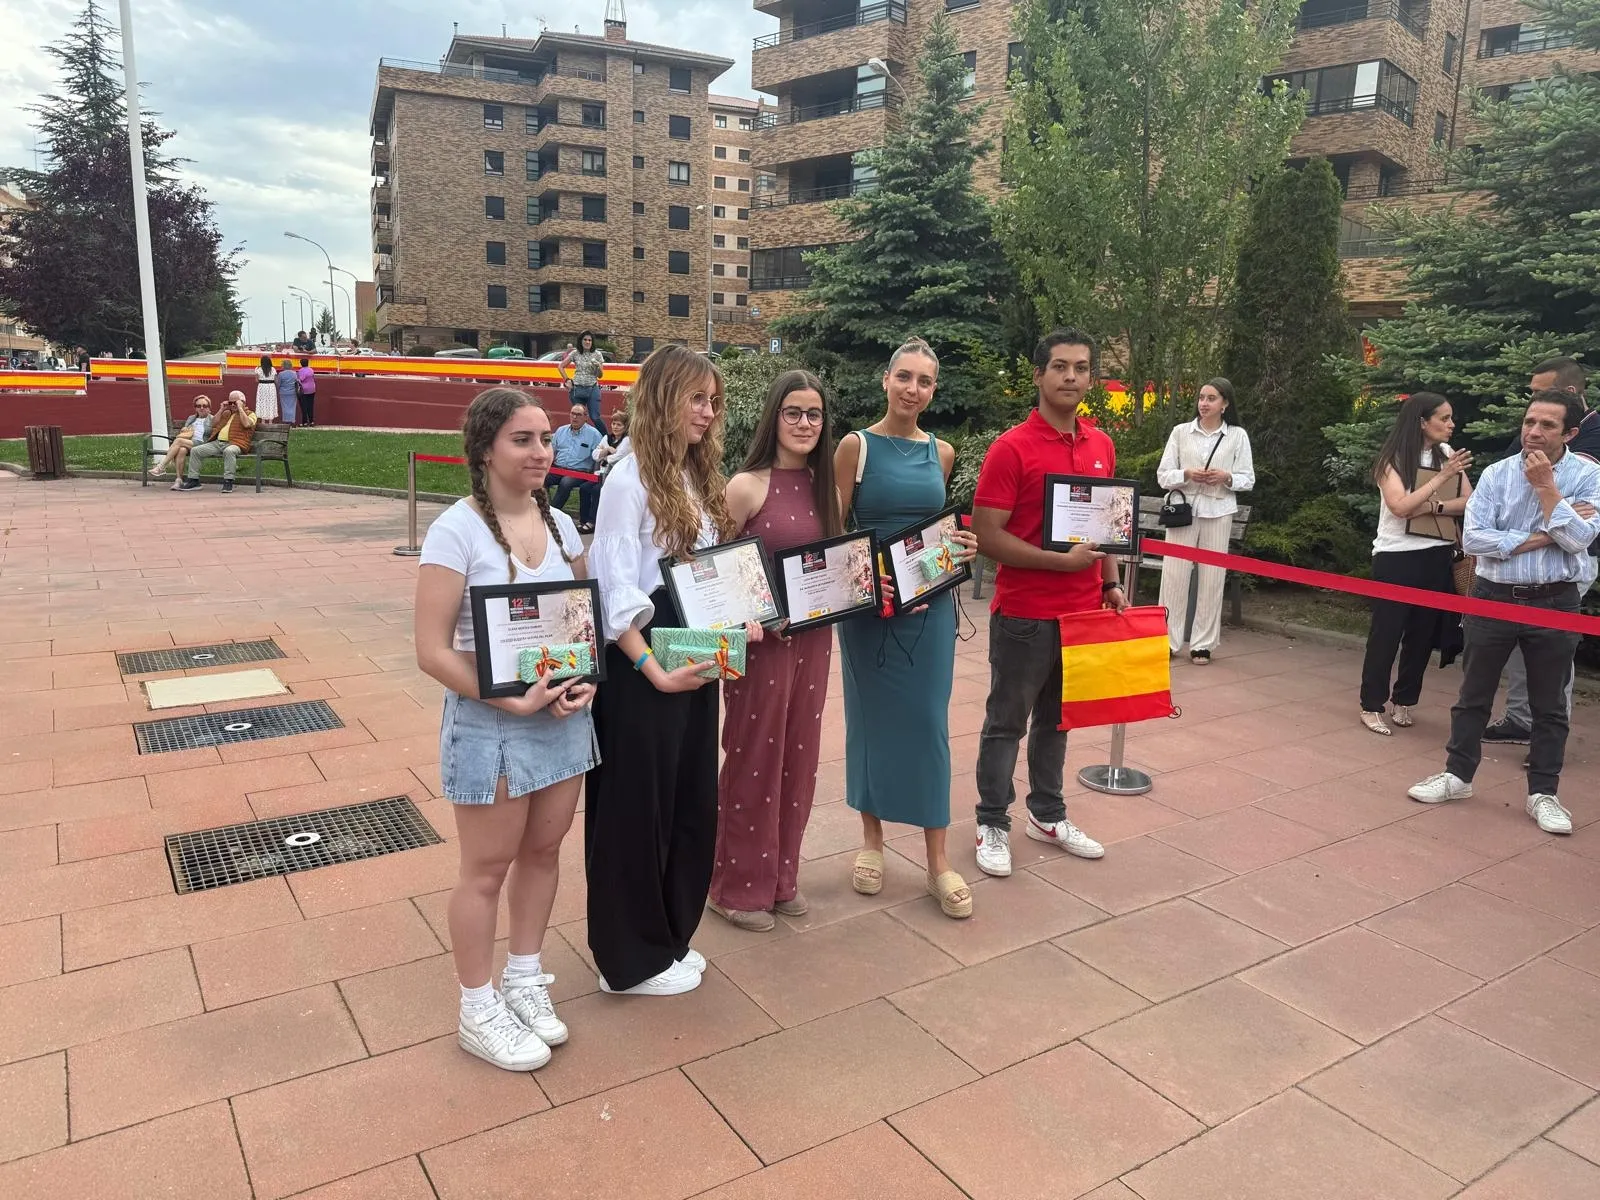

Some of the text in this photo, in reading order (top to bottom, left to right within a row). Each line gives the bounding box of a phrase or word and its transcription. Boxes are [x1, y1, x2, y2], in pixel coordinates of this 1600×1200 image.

[771, 339, 779, 352] P
[803, 553, 814, 563] 12
[511, 598, 523, 608] 12
